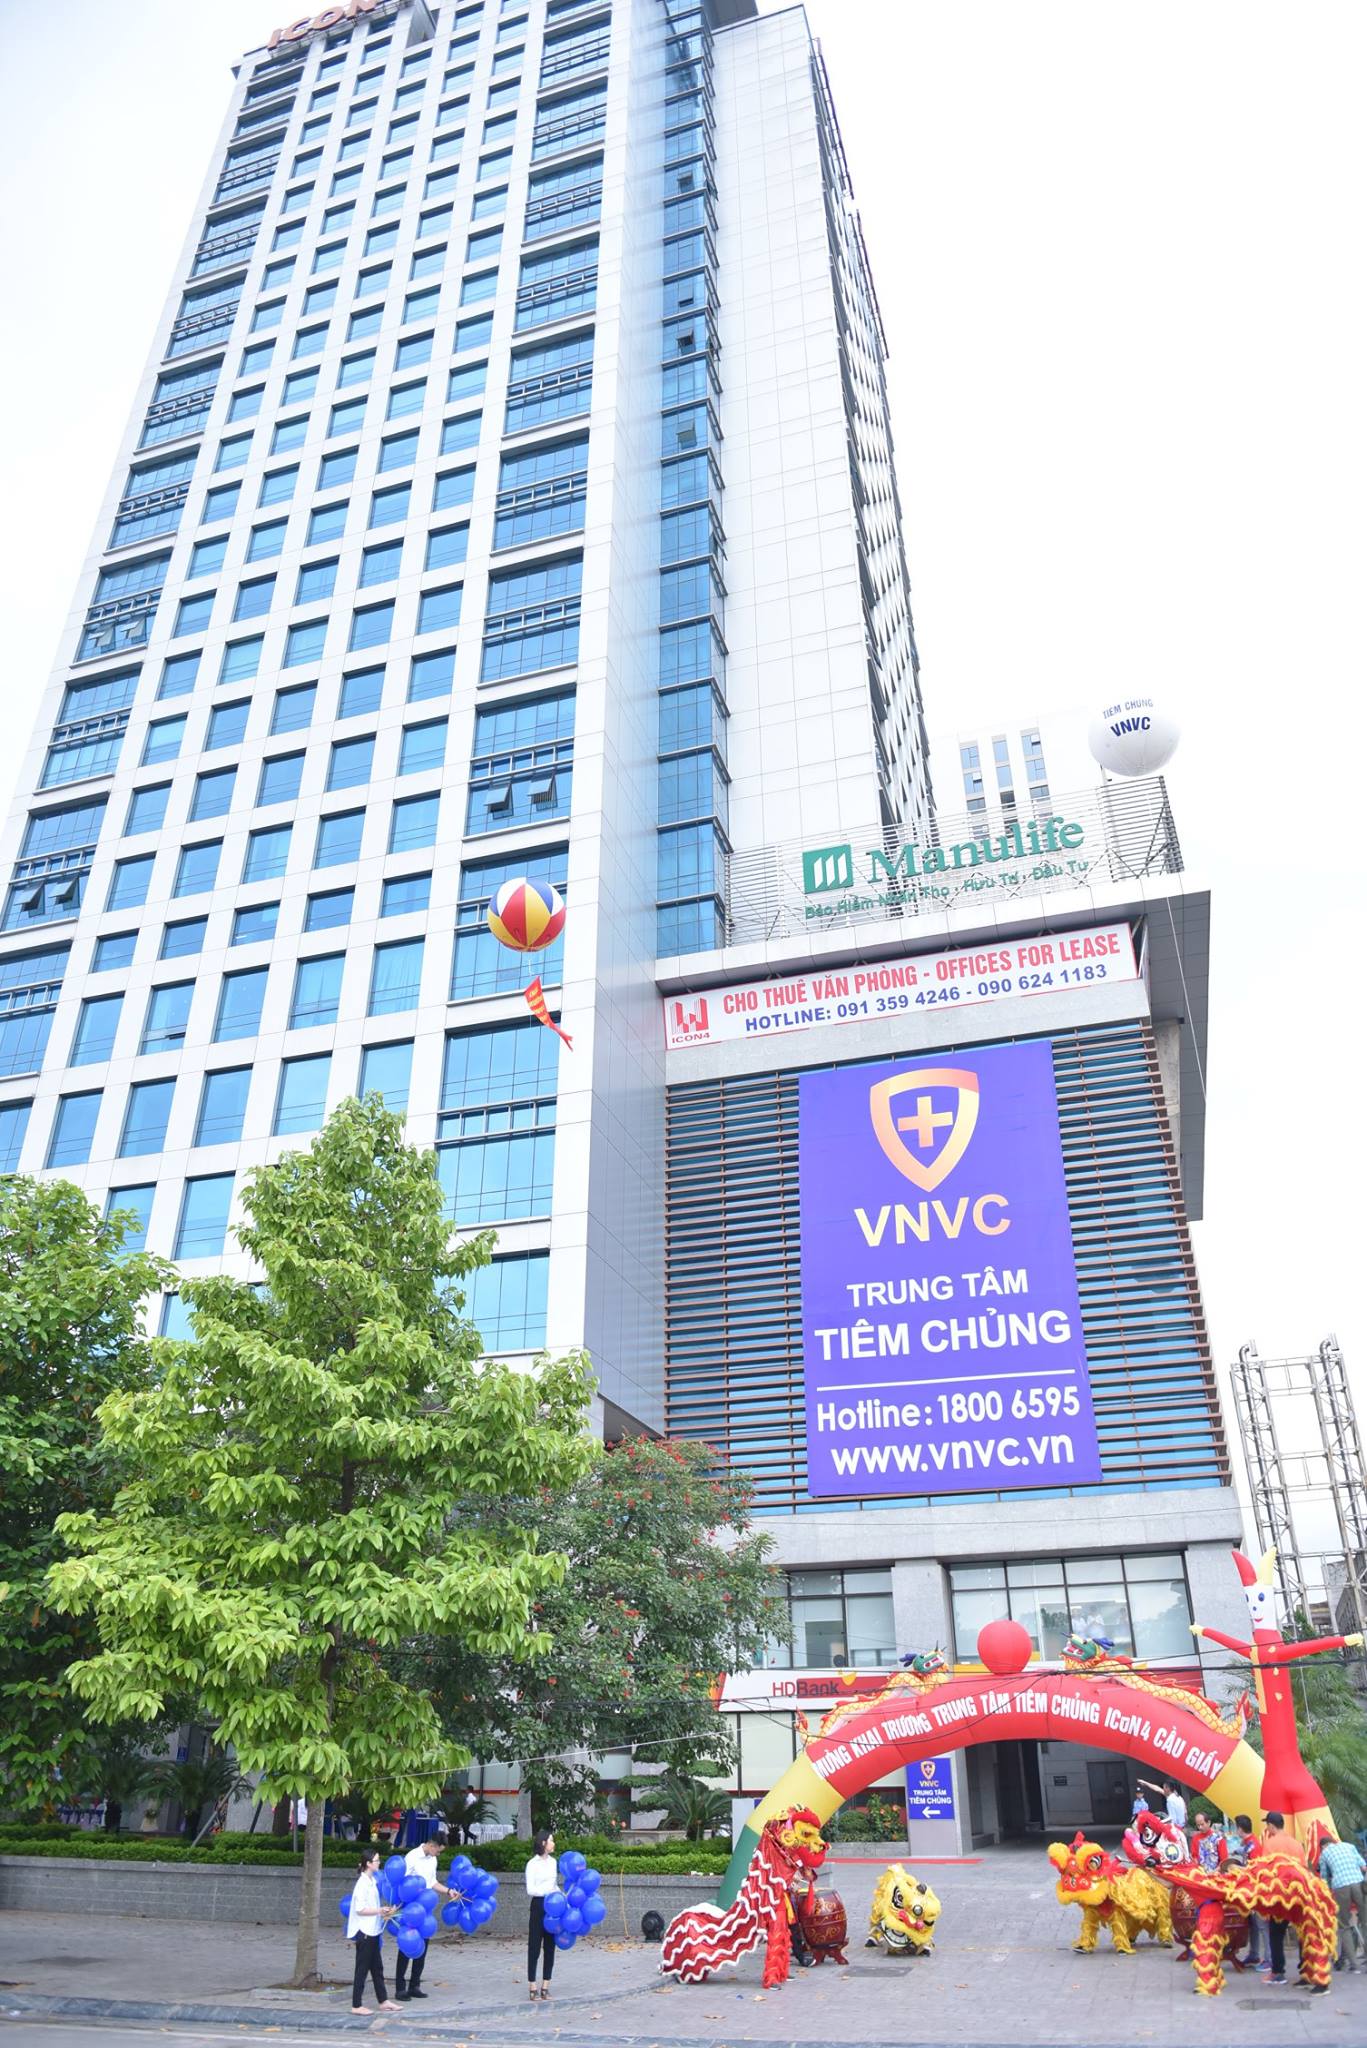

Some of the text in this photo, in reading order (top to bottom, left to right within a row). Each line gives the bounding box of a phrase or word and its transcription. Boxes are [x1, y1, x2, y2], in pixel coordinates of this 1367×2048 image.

[1110, 716, 1151, 737] VNVC
[865, 815, 1085, 883] Manulife
[723, 993, 758, 1014] CHO
[763, 979, 808, 1009] THUÊ
[812, 974, 849, 1000] VĂN
[854, 965, 918, 994] PHÒNG
[936, 950, 1013, 982] OFFICES
[1017, 943, 1054, 969] FOR
[1060, 933, 1121, 962] LEASE
[745, 1007, 832, 1032] HOTLINE:
[837, 1000, 868, 1018] 091
[876, 994, 908, 1012] 359
[915, 986, 960, 1005] 4246
[977, 978, 1012, 996] 090
[1018, 972, 1053, 990] 624
[1060, 964, 1107, 984] 1183
[672, 1032, 710, 1044] ICON4
[854, 1193, 1011, 1247] VNVC
[846, 1265, 1028, 1308] TRUNG TÂM
[814, 1307, 1072, 1361] TIÊM CHỦNG
[817, 1386, 1081, 1432] Hotline: 1800 6595
[830, 1432, 1075, 1476] www.vnvc.vn
[772, 1680, 840, 1697] HDBank
[851, 1727, 884, 1758] KHAI
[931, 1696, 977, 1727] TRUNG
[980, 1691, 1011, 1715] TÂM
[1013, 1688, 1048, 1713] TIÊM
[1051, 1692, 1100, 1724] CHỦNG
[1185, 1750, 1224, 1780] GIẤY
[909, 1796, 926, 1804] TIÊM
[934, 1788, 947, 1796] TÂM
